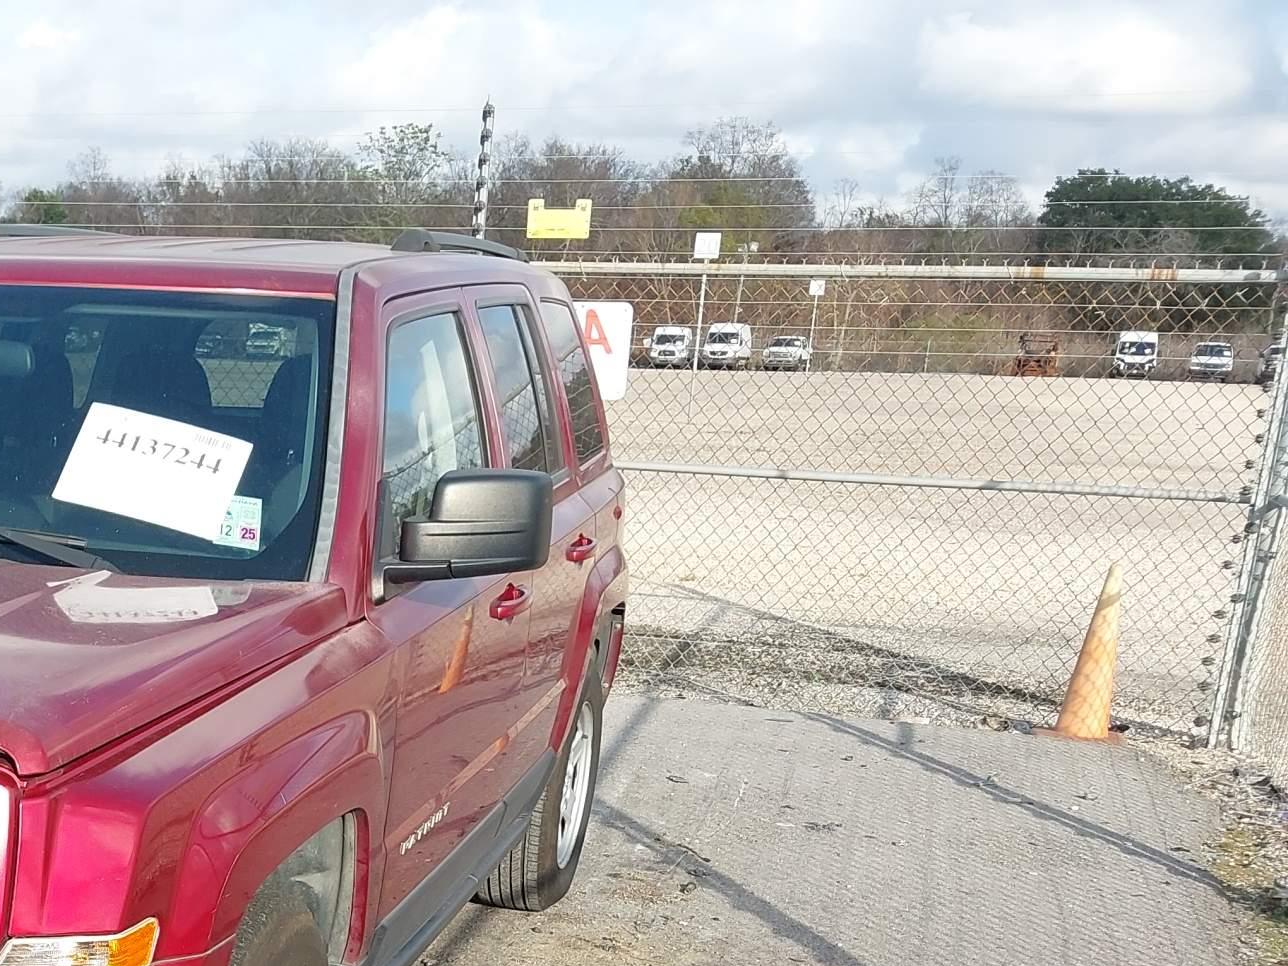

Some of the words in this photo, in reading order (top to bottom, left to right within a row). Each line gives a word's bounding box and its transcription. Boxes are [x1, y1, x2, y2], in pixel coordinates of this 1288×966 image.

[584, 308, 613, 354] A
[95, 427, 223, 475] 44137244
[240, 526, 257, 541] 25
